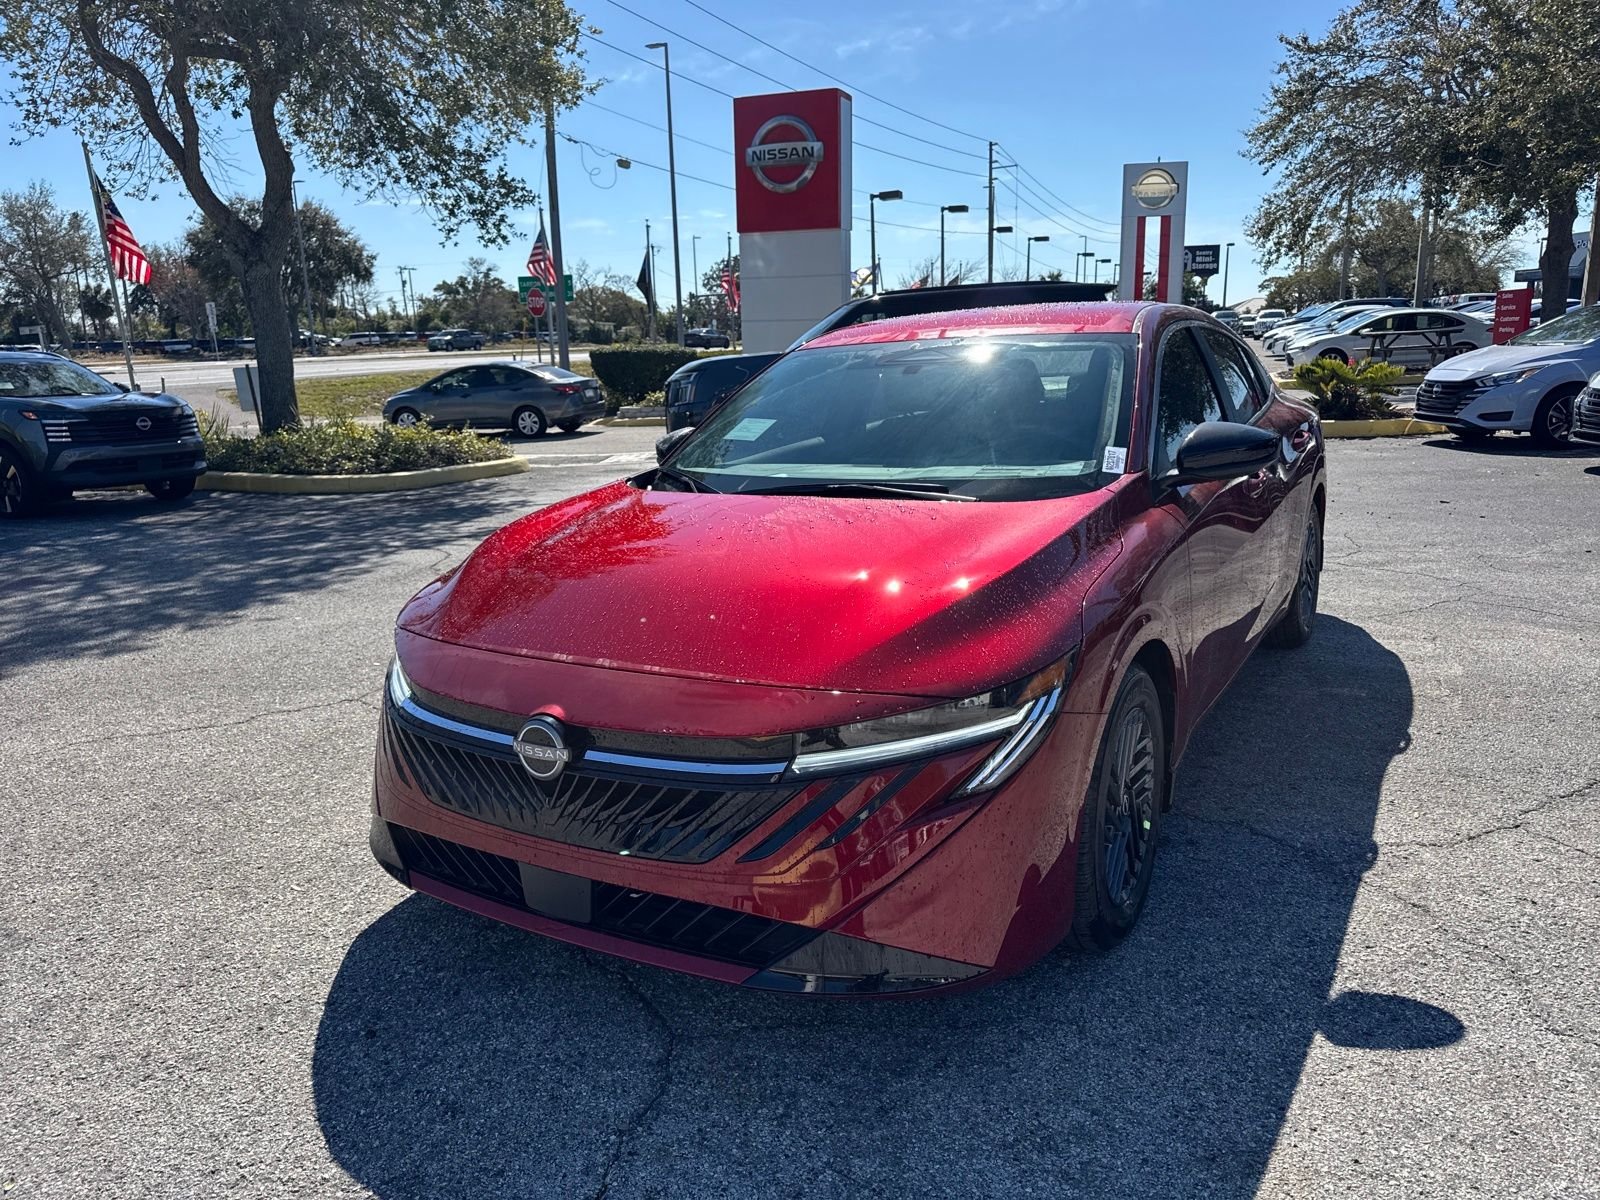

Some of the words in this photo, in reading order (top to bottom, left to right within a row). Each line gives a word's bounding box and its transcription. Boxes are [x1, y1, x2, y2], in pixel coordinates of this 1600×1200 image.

[751, 146, 814, 162] NISSAN
[1191, 262, 1218, 270] Storage
[528, 296, 545, 309] STOP
[1499, 326, 1516, 334] Parking
[513, 742, 567, 760] NISSAN
